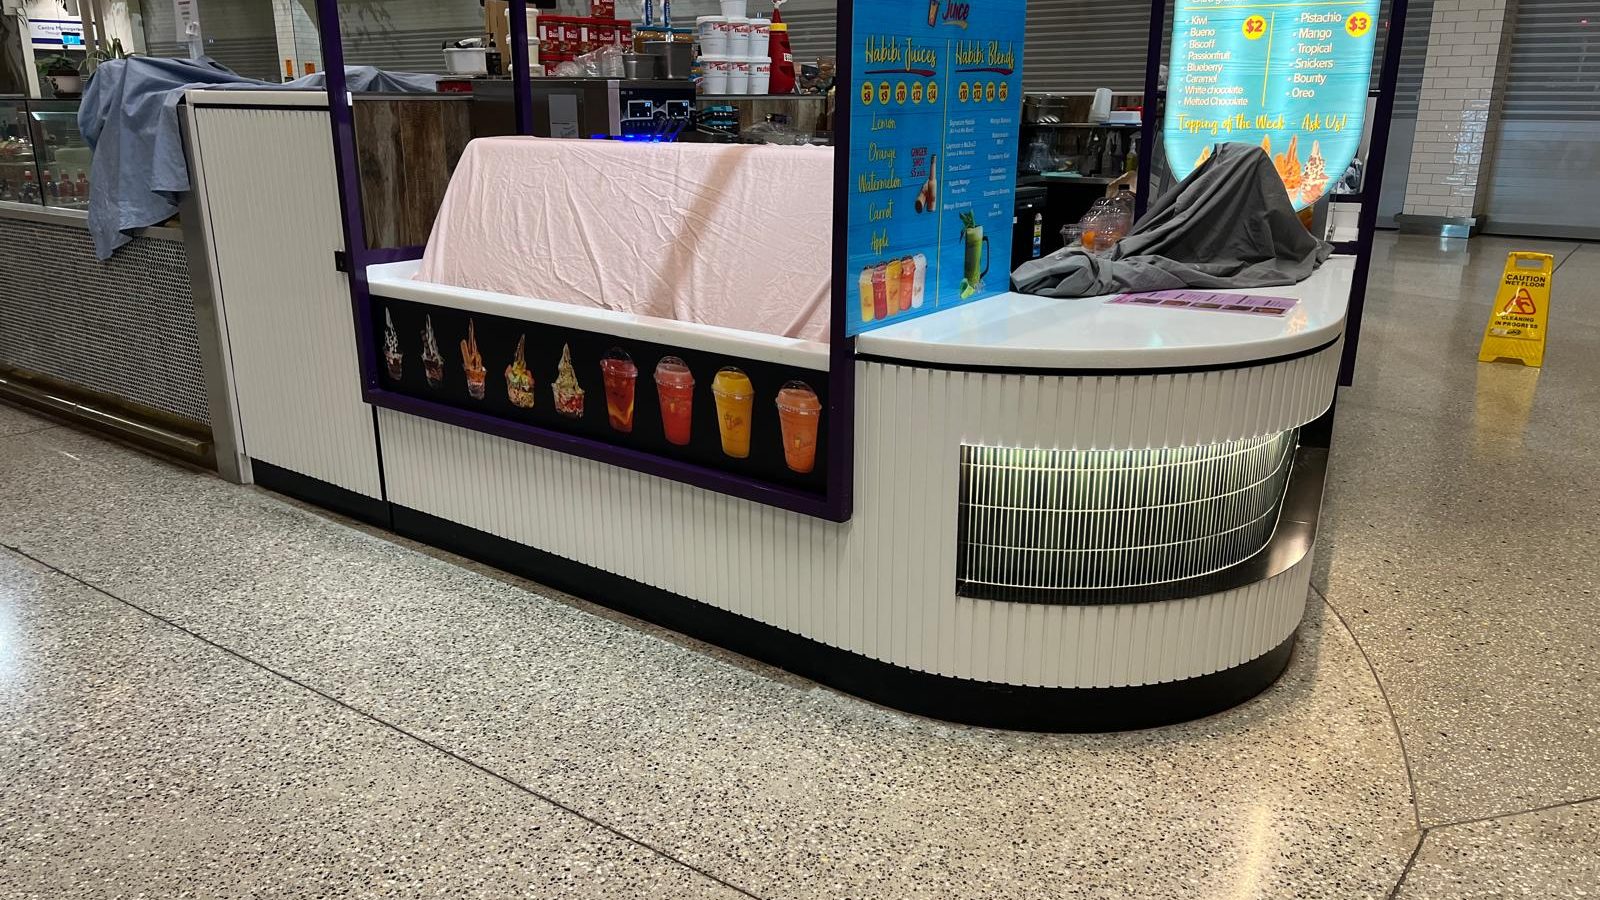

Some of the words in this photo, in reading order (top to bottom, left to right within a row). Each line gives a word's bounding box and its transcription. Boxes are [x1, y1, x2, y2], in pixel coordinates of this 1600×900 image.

[942, 0, 970, 20] Juice
[1191, 15, 1208, 25] Kiwi
[1300, 12, 1342, 23] Pistachio
[1349, 14, 1368, 32] $3
[1245, 18, 1264, 34] $2
[1190, 28, 1216, 37] Bueno
[1299, 28, 1332, 40] Mango
[1189, 40, 1217, 49] Biscoff
[1297, 43, 1333, 55] Tropical
[865, 35, 901, 64] Habibi
[904, 37, 936, 71] Juices
[955, 40, 984, 65] Habibi
[987, 41, 1015, 71] Blends
[1188, 51, 1231, 60] Passionfruit
[1187, 62, 1224, 73] Blueberry
[1295, 58, 1334, 69] Snickers
[1185, 74, 1217, 83] Caramel
[1293, 72, 1327, 85] Bounty
[1184, 86, 1206, 95] White
[1206, 86, 1244, 95] chocolate
[1292, 88, 1315, 98] Oreo
[1184, 97, 1209, 106] Melted
[1210, 97, 1248, 106] Chocolate
[871, 112, 896, 131] Lemon
[1177, 113, 1218, 135] Topping
[1222, 114, 1234, 134] of
[1236, 113, 1251, 129] the
[1256, 113, 1285, 130] Week
[1302, 112, 1321, 131] Ask
[1325, 114, 1347, 133] Us!
[868, 143, 897, 168] Orange
[859, 169, 902, 193] Watermelon
[869, 200, 893, 222] Carrot
[871, 228, 889, 256] Apple
[1506, 274, 1546, 282] CAUTION
